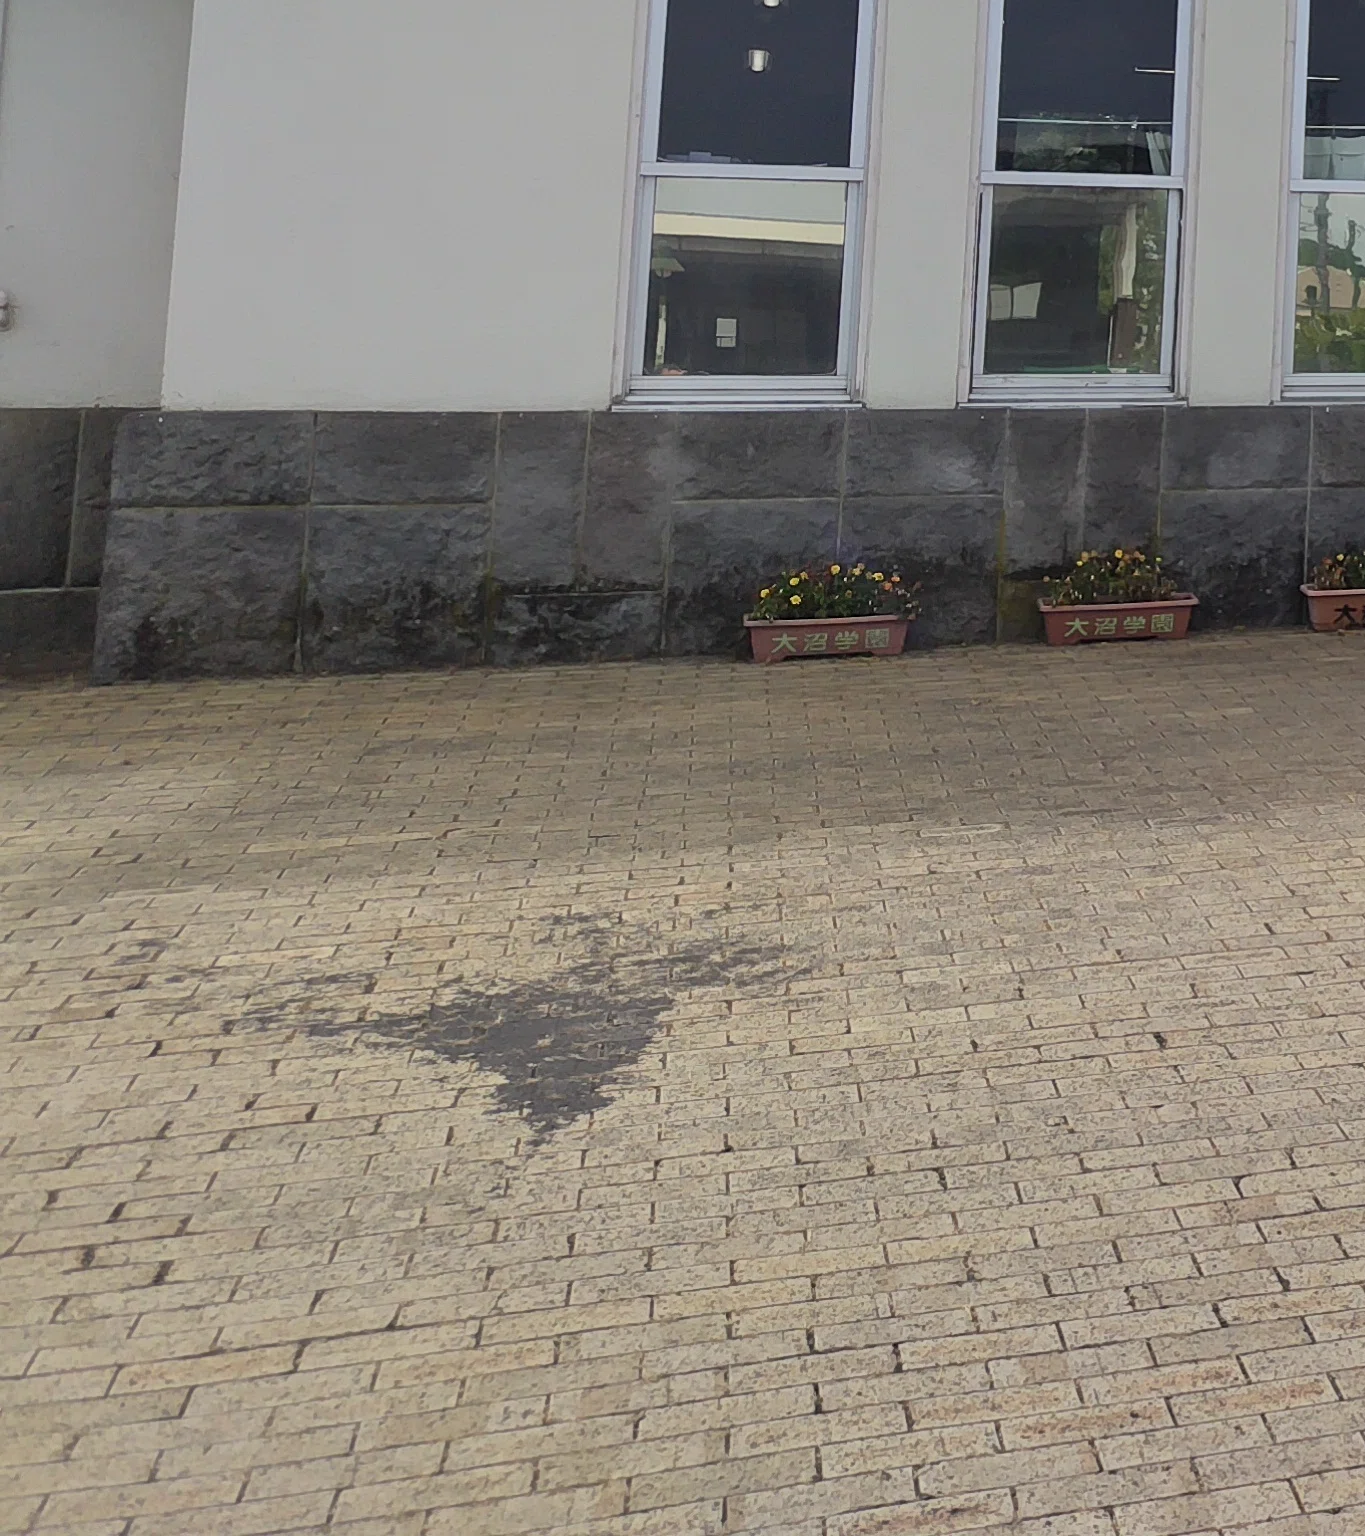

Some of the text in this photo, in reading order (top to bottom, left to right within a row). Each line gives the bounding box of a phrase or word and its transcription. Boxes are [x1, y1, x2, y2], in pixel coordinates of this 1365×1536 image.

[1064, 613, 1175, 637] 大沼学園
[771, 628, 890, 654] 大沼学園
